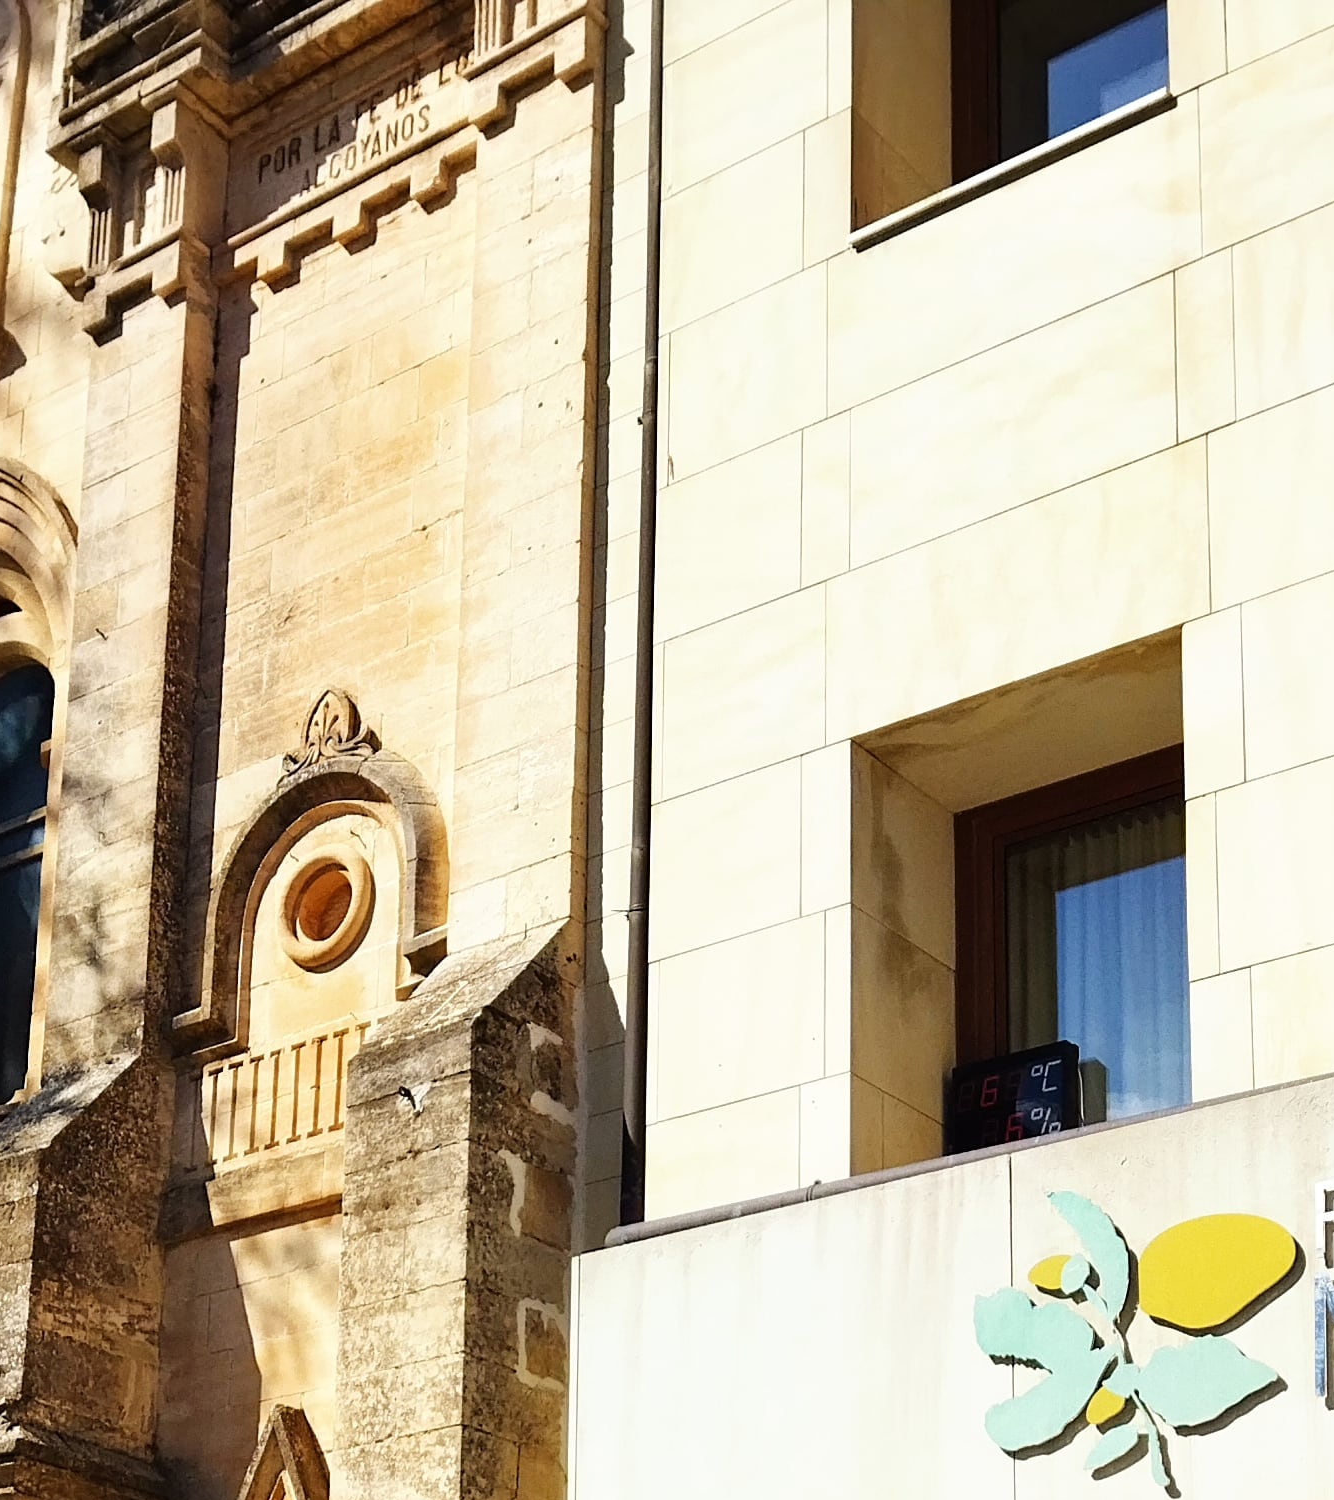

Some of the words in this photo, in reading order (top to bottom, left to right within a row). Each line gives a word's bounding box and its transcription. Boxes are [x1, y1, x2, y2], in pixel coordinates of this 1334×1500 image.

[257, 137, 303, 184] POR
[314, 112, 341, 153] LA
[354, 88, 384, 128] FE
[299, 103, 431, 198] ALCOYANOS
